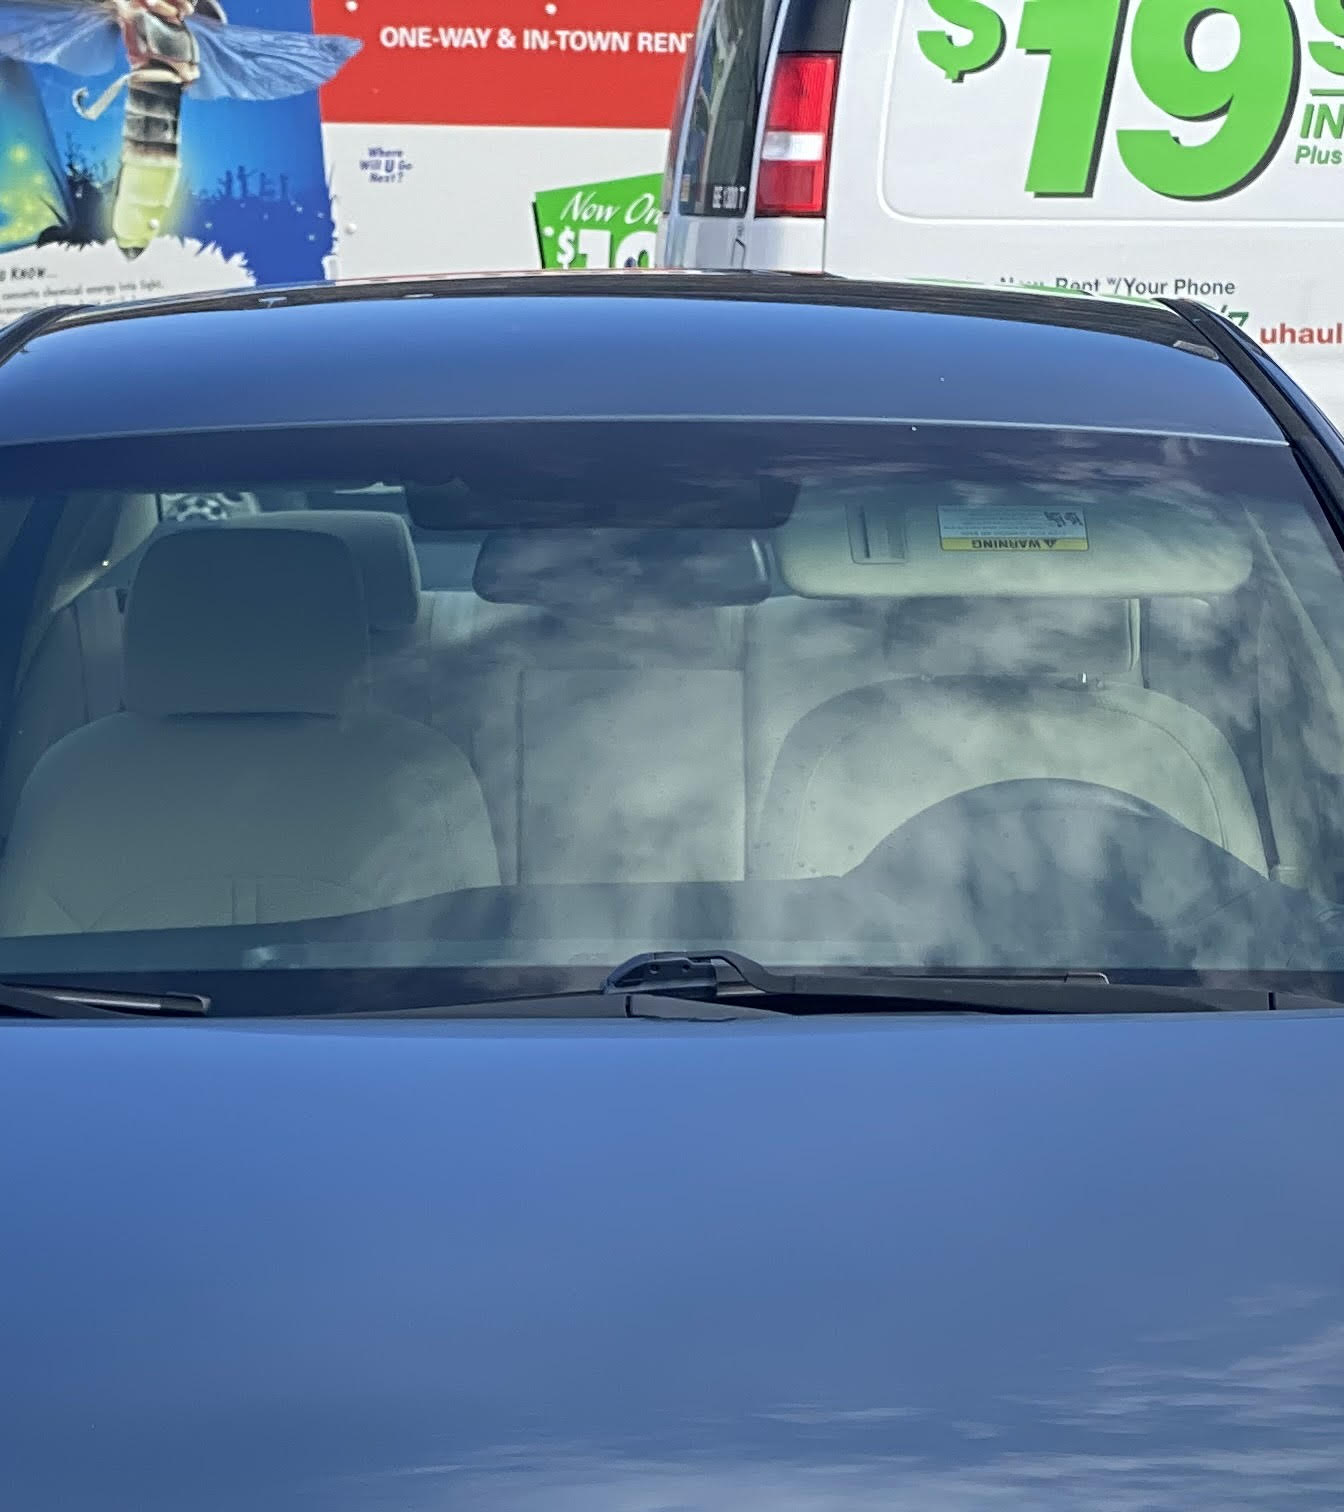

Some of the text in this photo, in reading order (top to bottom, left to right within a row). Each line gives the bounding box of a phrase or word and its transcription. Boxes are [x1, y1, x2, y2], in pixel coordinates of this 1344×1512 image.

[379, 26, 693, 53] ONE-WAY & IN-TOWN REN
[1294, 145, 1343, 165] Plus
[385, 158, 394, 173] U
[559, 191, 621, 223] Now
[1174, 278, 1236, 296] Phone
[971, 539, 1042, 549] WARNING
